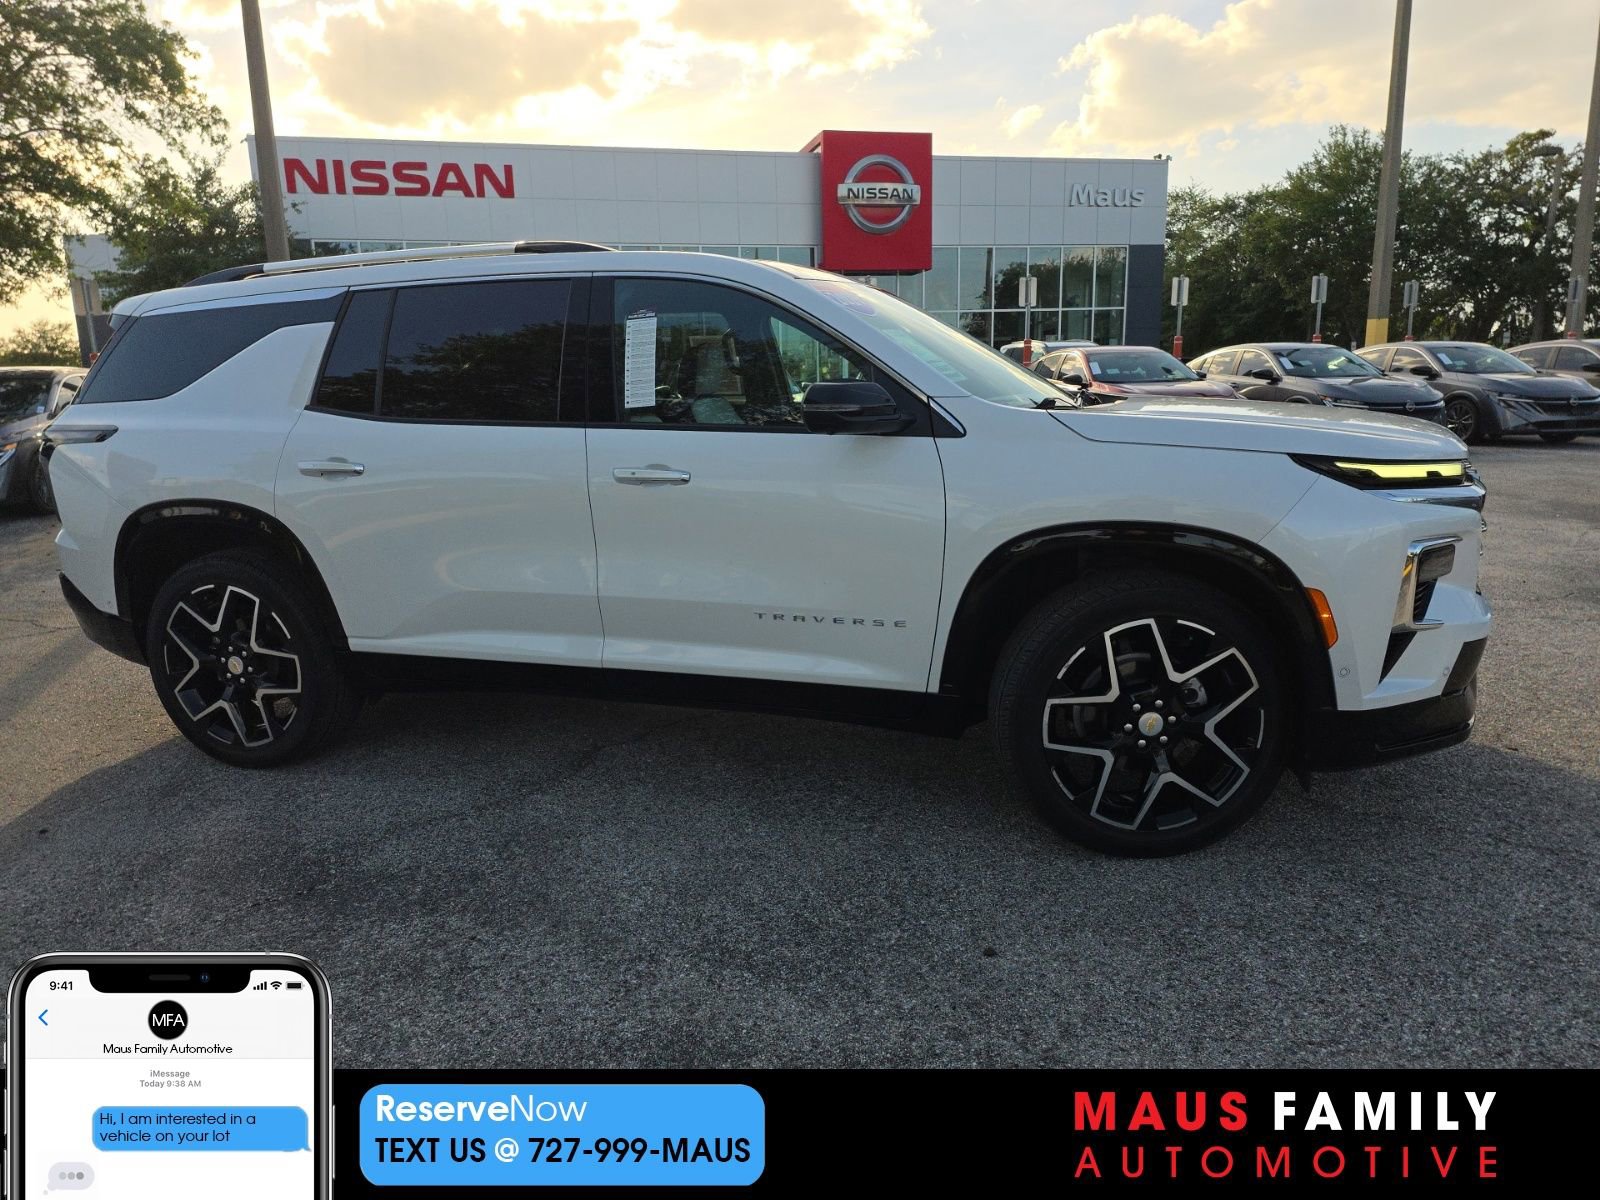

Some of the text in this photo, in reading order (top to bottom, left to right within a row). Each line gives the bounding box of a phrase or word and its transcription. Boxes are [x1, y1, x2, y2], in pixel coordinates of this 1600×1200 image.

[283, 157, 515, 199] NISSAN
[847, 186, 915, 201] NISSAN
[1069, 183, 1146, 208] Maus
[753, 612, 908, 629] TRAVERSE
